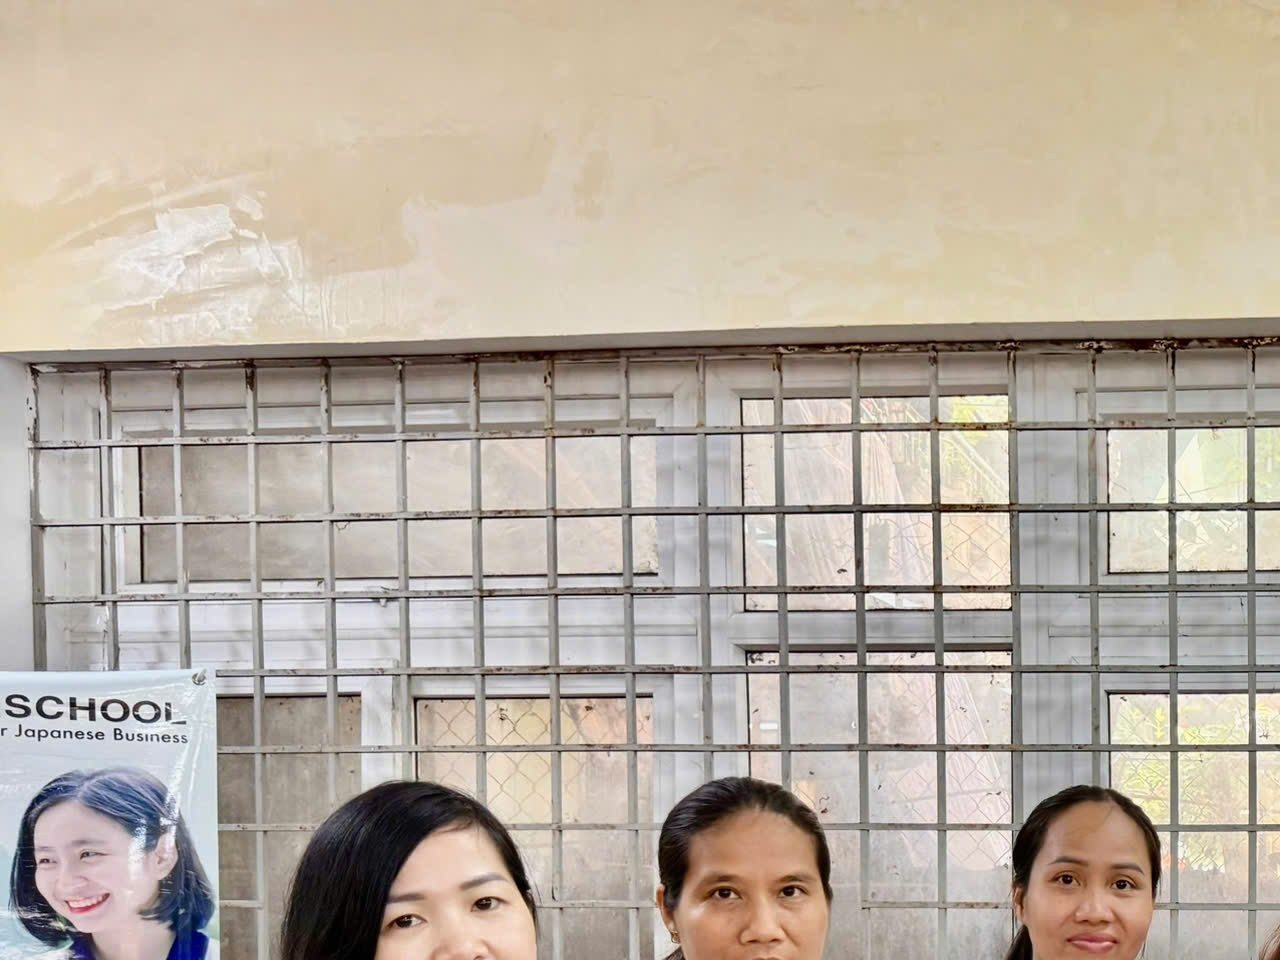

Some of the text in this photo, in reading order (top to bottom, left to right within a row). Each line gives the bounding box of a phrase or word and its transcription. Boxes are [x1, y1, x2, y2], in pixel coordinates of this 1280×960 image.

[5, 694, 187, 724] SCHOOL
[15, 724, 105, 742] Japanese
[113, 728, 188, 743] Business
